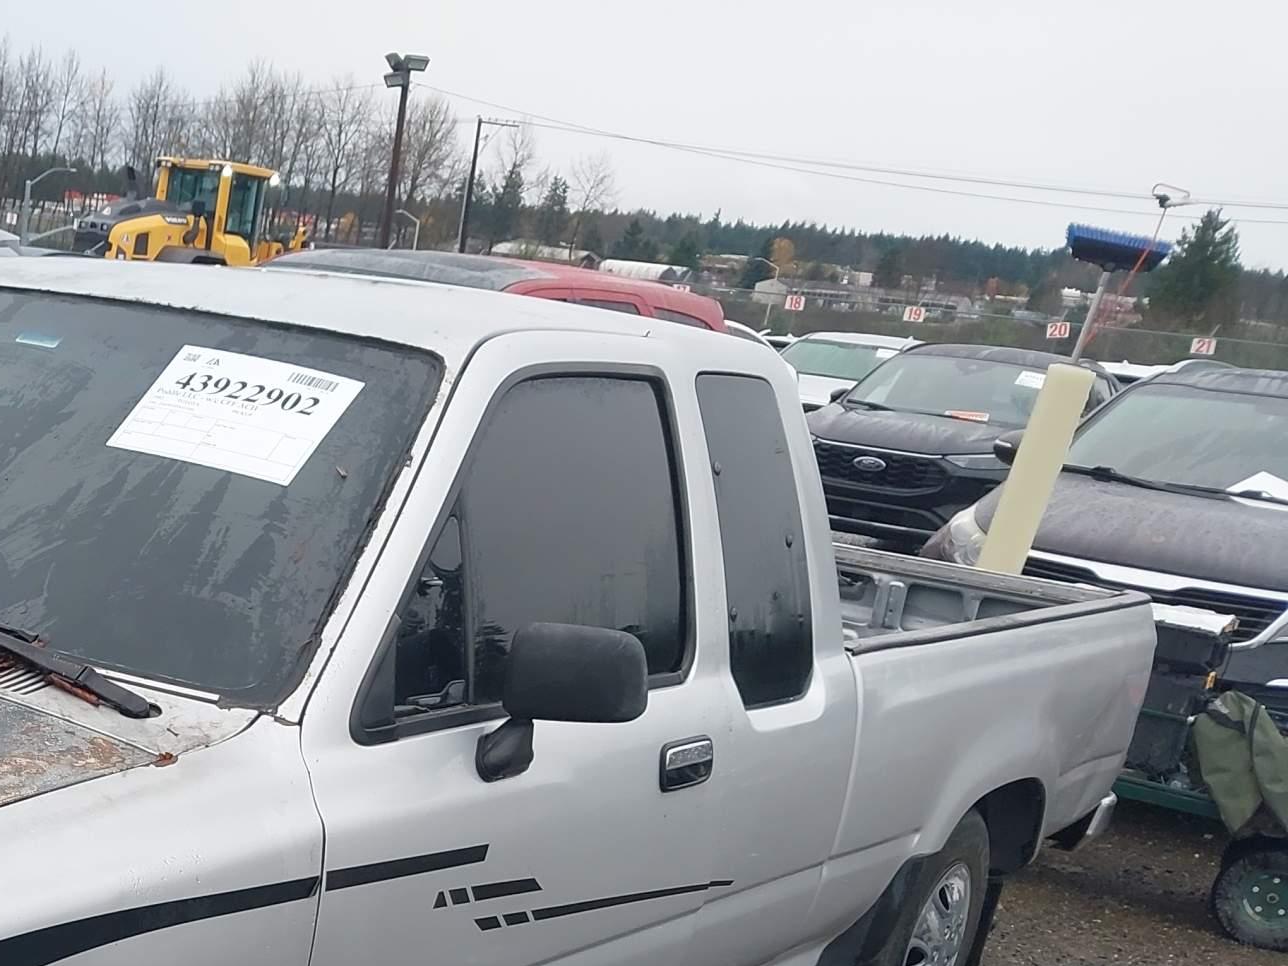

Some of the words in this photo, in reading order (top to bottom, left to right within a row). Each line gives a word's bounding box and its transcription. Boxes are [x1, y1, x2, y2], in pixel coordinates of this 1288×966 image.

[789, 296, 802, 310] 18
[908, 307, 922, 321] 19
[1048, 323, 1068, 337] 20
[1196, 339, 1211, 354] 21
[175, 371, 320, 416] 43922902
